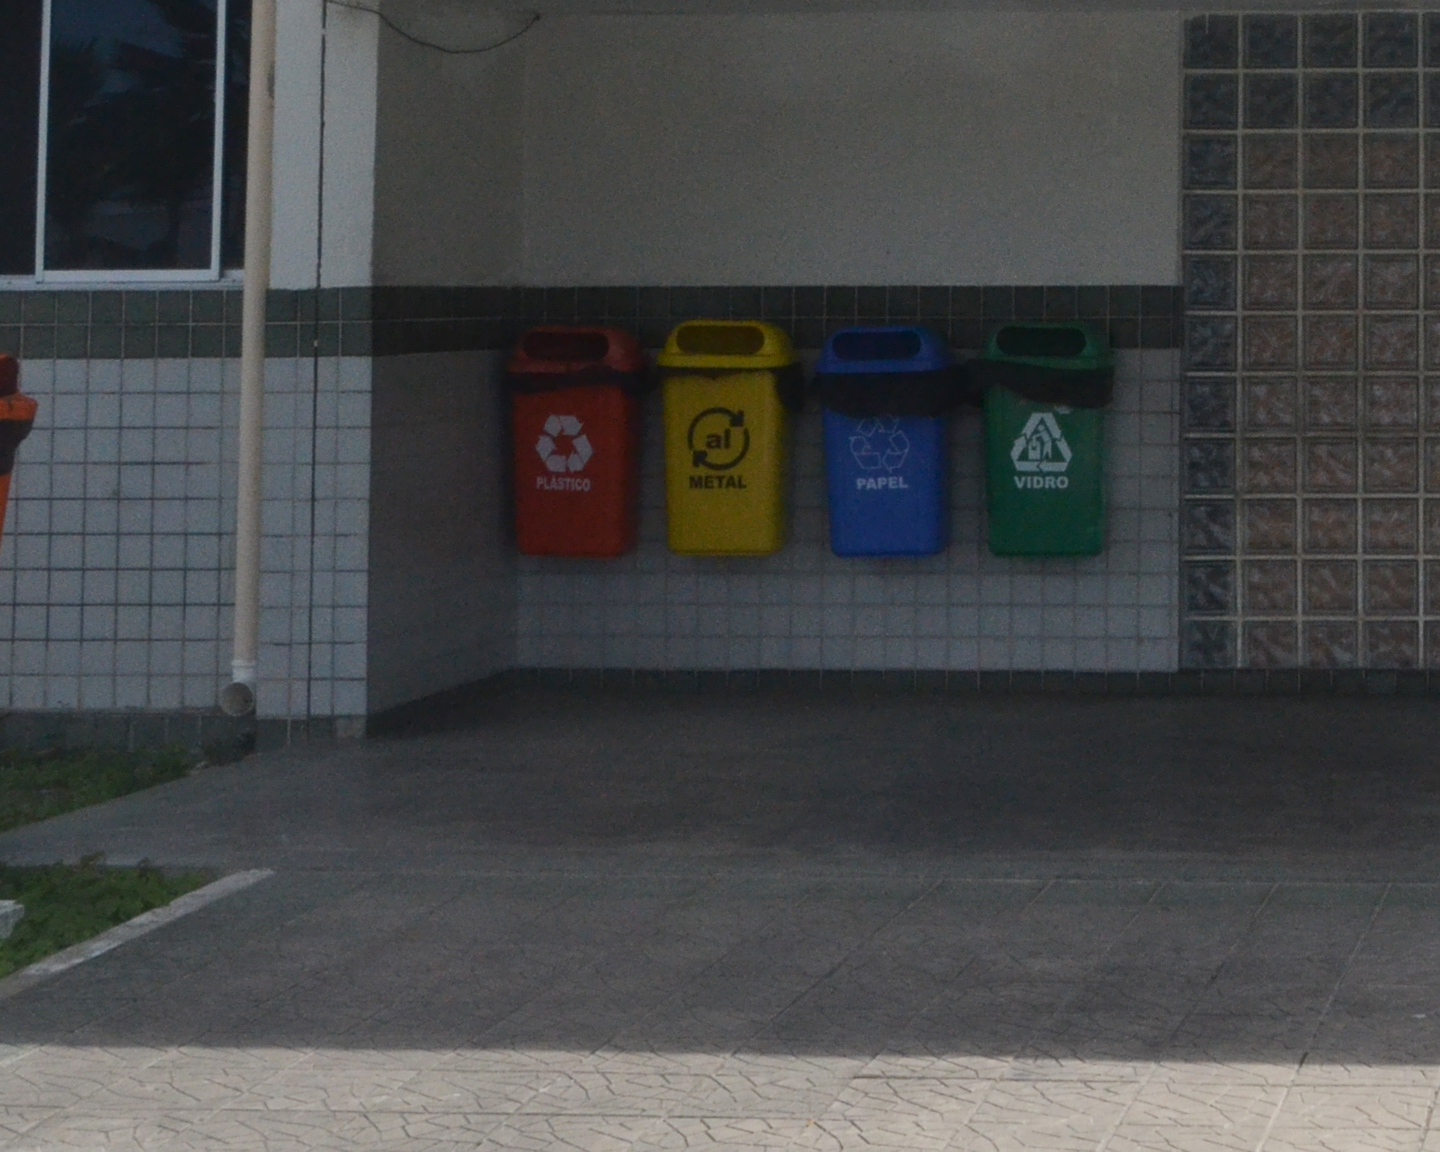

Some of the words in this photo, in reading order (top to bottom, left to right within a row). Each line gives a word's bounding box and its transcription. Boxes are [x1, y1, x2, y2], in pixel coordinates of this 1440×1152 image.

[689, 475, 746, 489] METAL
[856, 477, 908, 490] PAPEL
[1014, 475, 1068, 489] VIDRO
